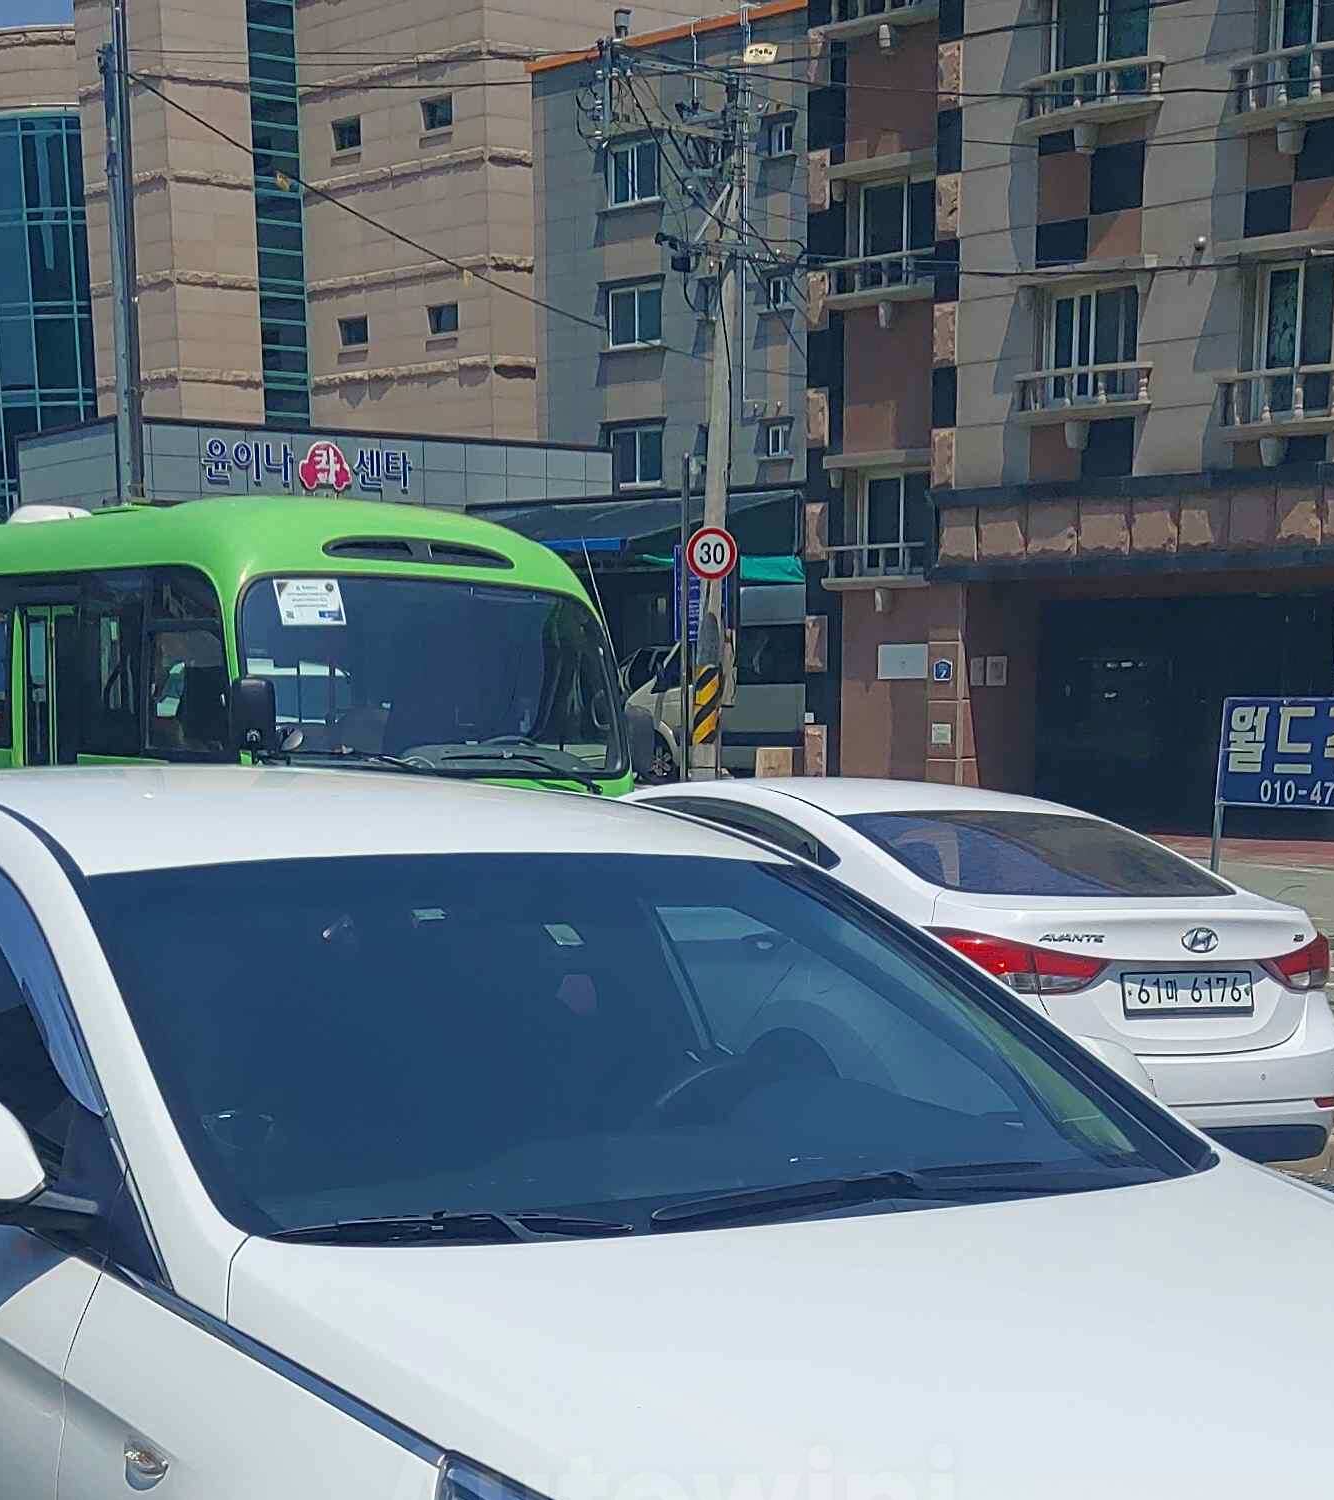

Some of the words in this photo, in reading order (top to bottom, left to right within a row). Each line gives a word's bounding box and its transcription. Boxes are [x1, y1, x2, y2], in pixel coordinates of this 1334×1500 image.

[700, 542, 725, 564] 30
[1039, 934, 1105, 943] AVANTE
[1190, 977, 1242, 1003] 6176
